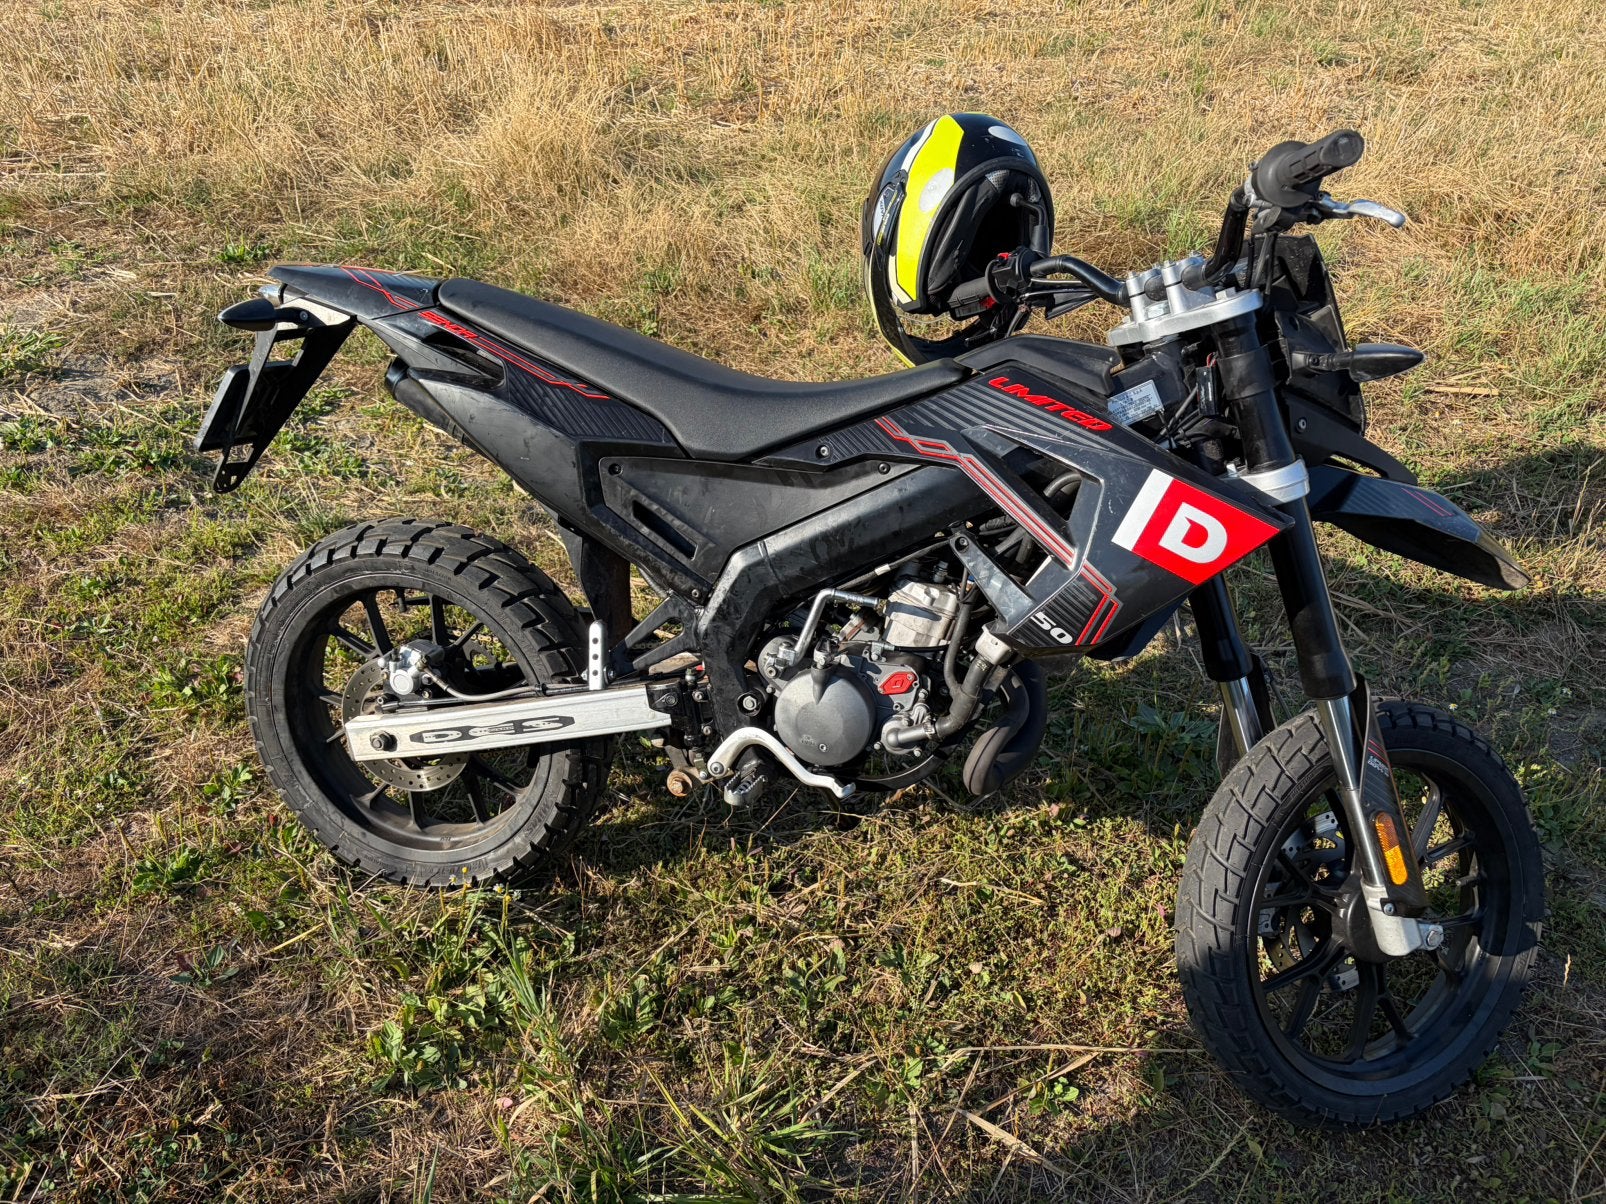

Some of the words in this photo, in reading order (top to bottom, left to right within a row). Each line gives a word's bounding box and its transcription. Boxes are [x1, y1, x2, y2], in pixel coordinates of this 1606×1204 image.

[988, 376, 1113, 431] LIMITED
[1158, 501, 1228, 564] D
[1030, 611, 1073, 644] 50
